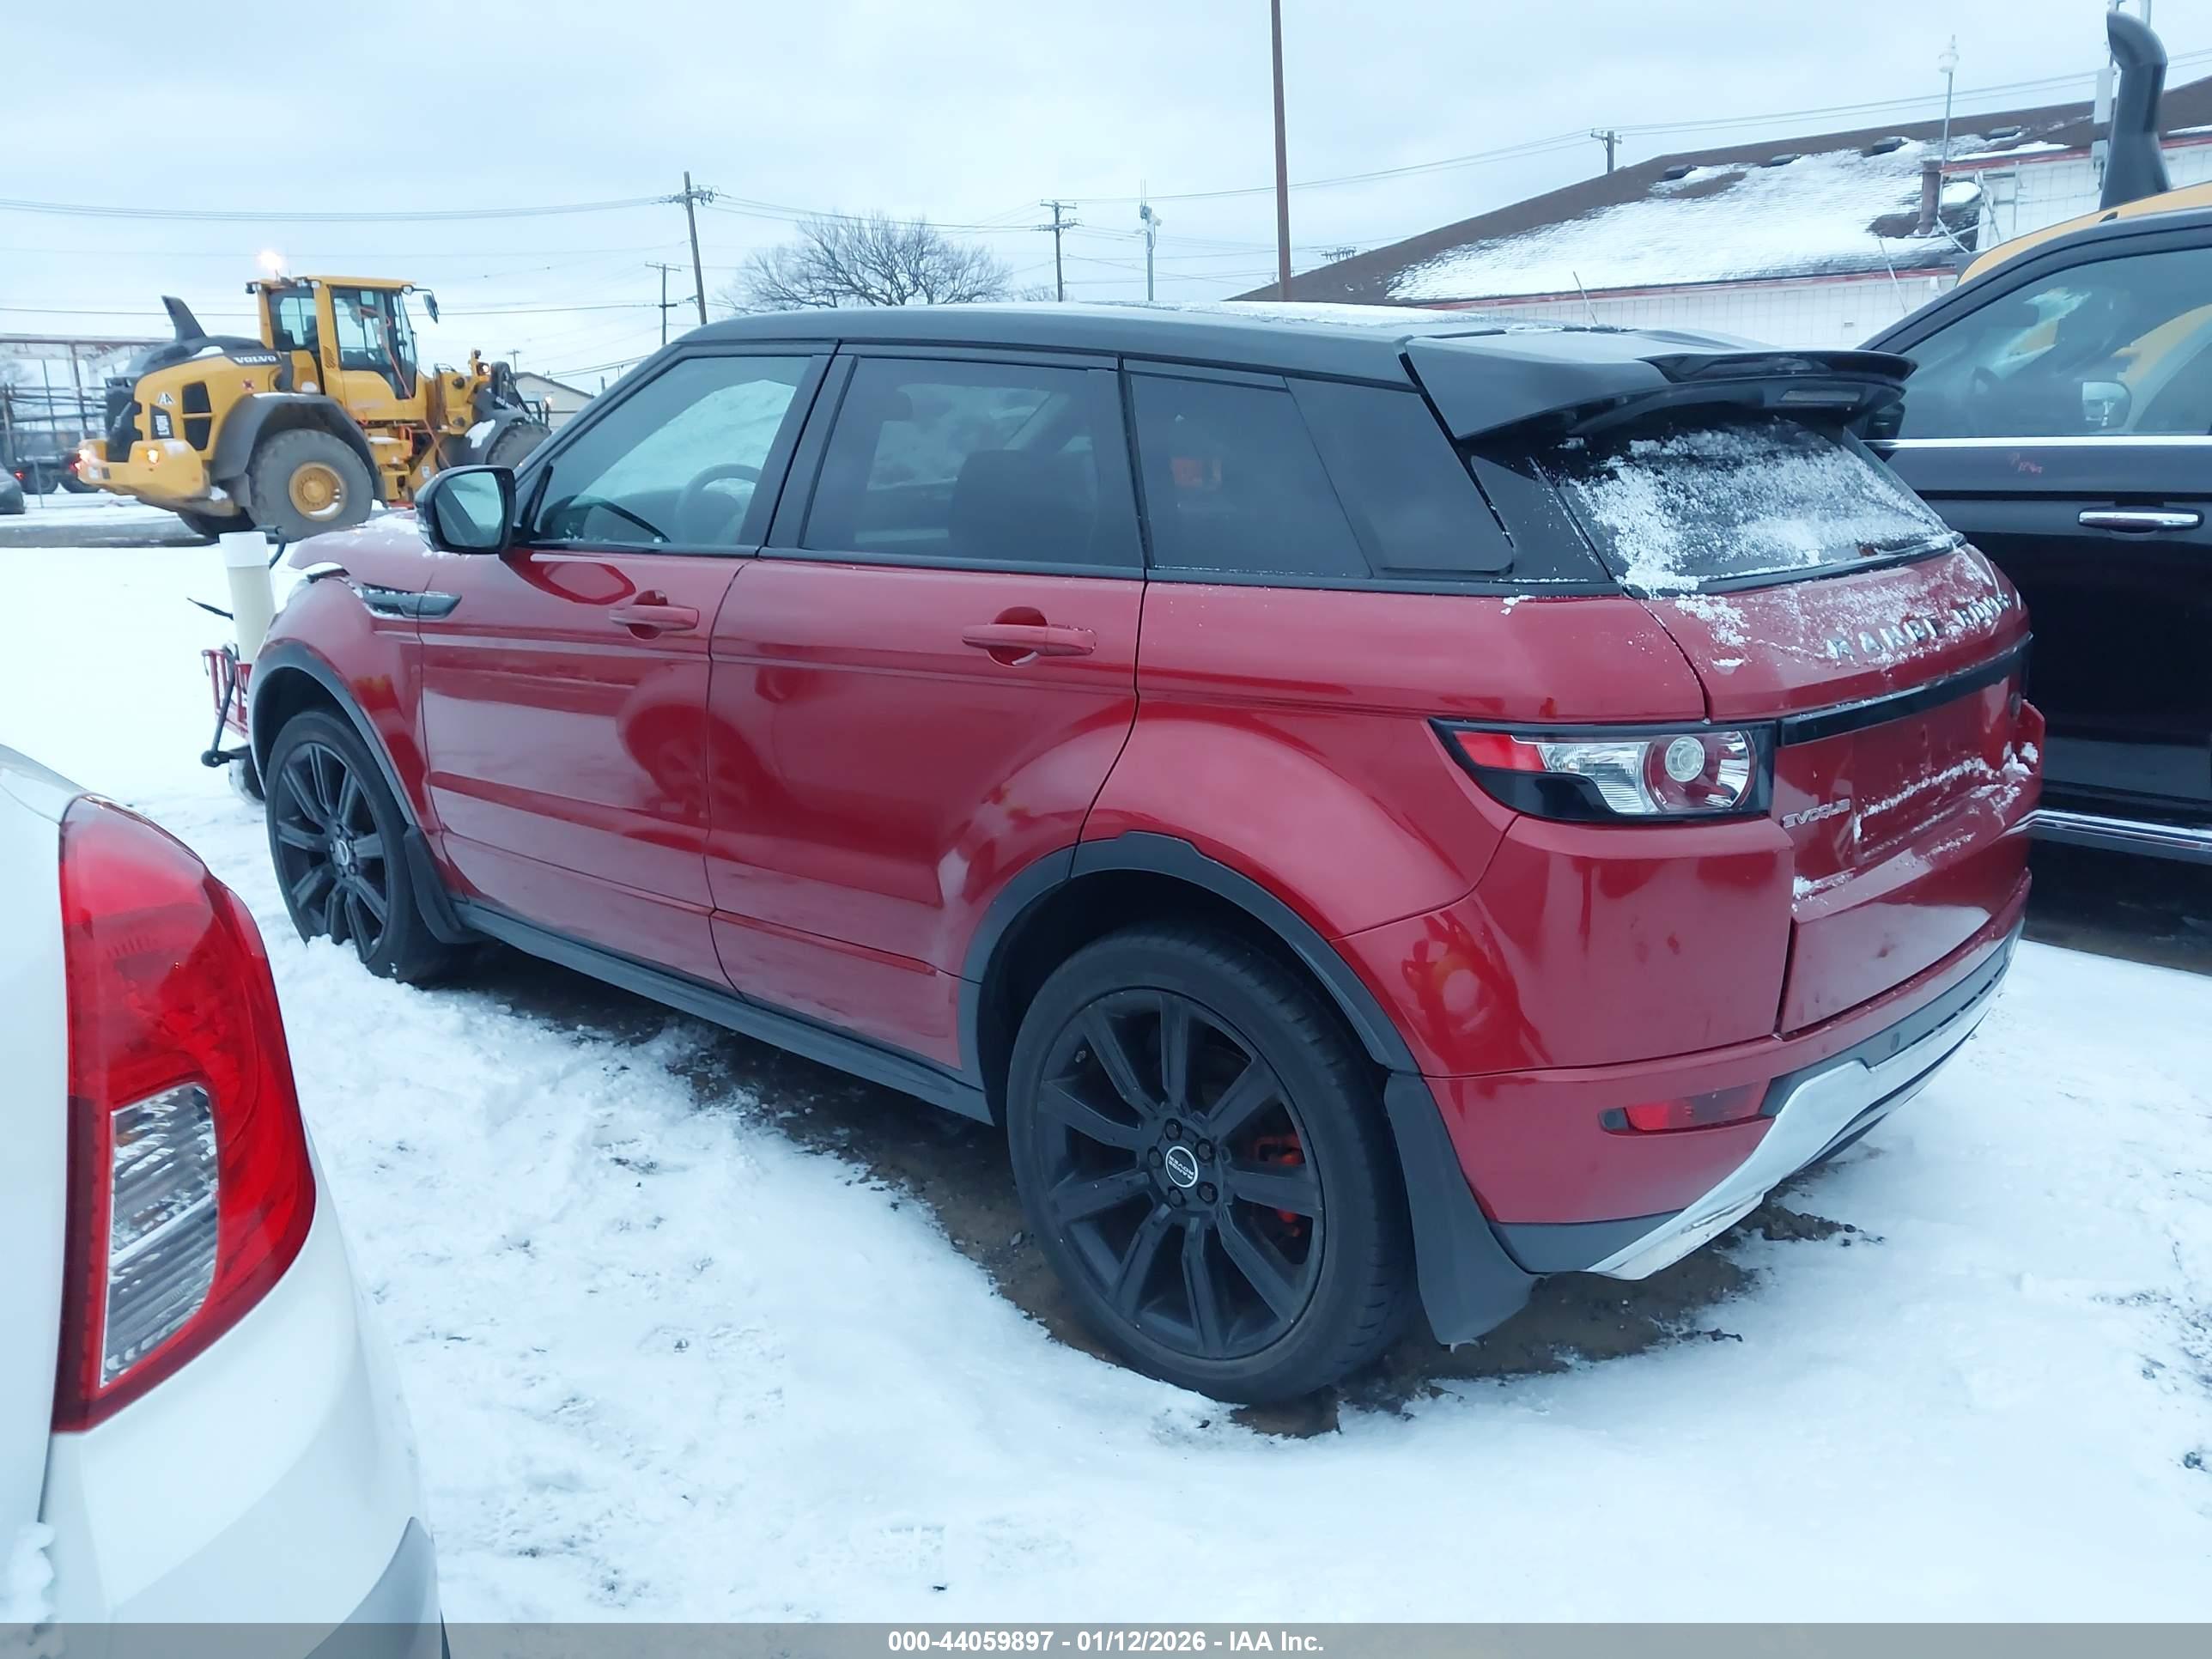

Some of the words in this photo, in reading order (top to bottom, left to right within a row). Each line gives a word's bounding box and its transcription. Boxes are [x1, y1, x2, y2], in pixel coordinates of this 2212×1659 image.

[233, 355, 276, 363] VOLVO
[1783, 798, 1850, 829] EVOQUE
[1169, 1156, 1194, 1175] ROVER
[1169, 1161, 1193, 1179] RANGE
